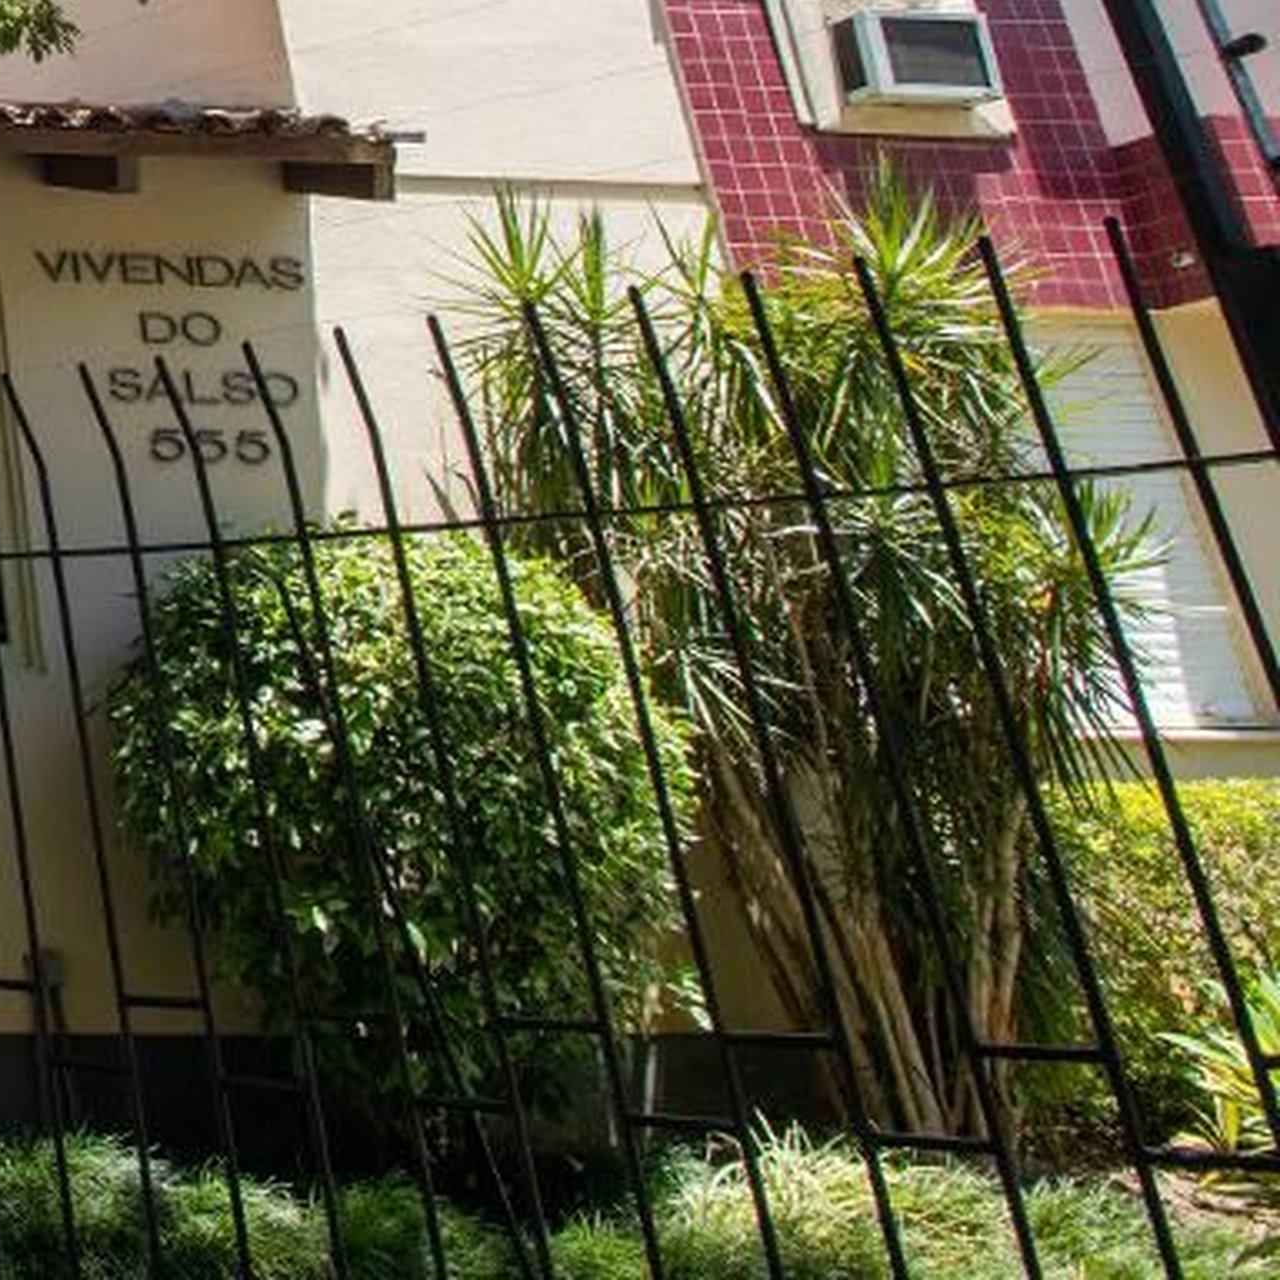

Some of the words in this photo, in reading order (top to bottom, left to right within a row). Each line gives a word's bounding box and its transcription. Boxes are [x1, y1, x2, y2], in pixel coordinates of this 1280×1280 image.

[34, 249, 305, 290] VIVENDAS
[140, 311, 222, 347] DO
[107, 366, 300, 407] SALSO
[149, 427, 272, 464] 555
